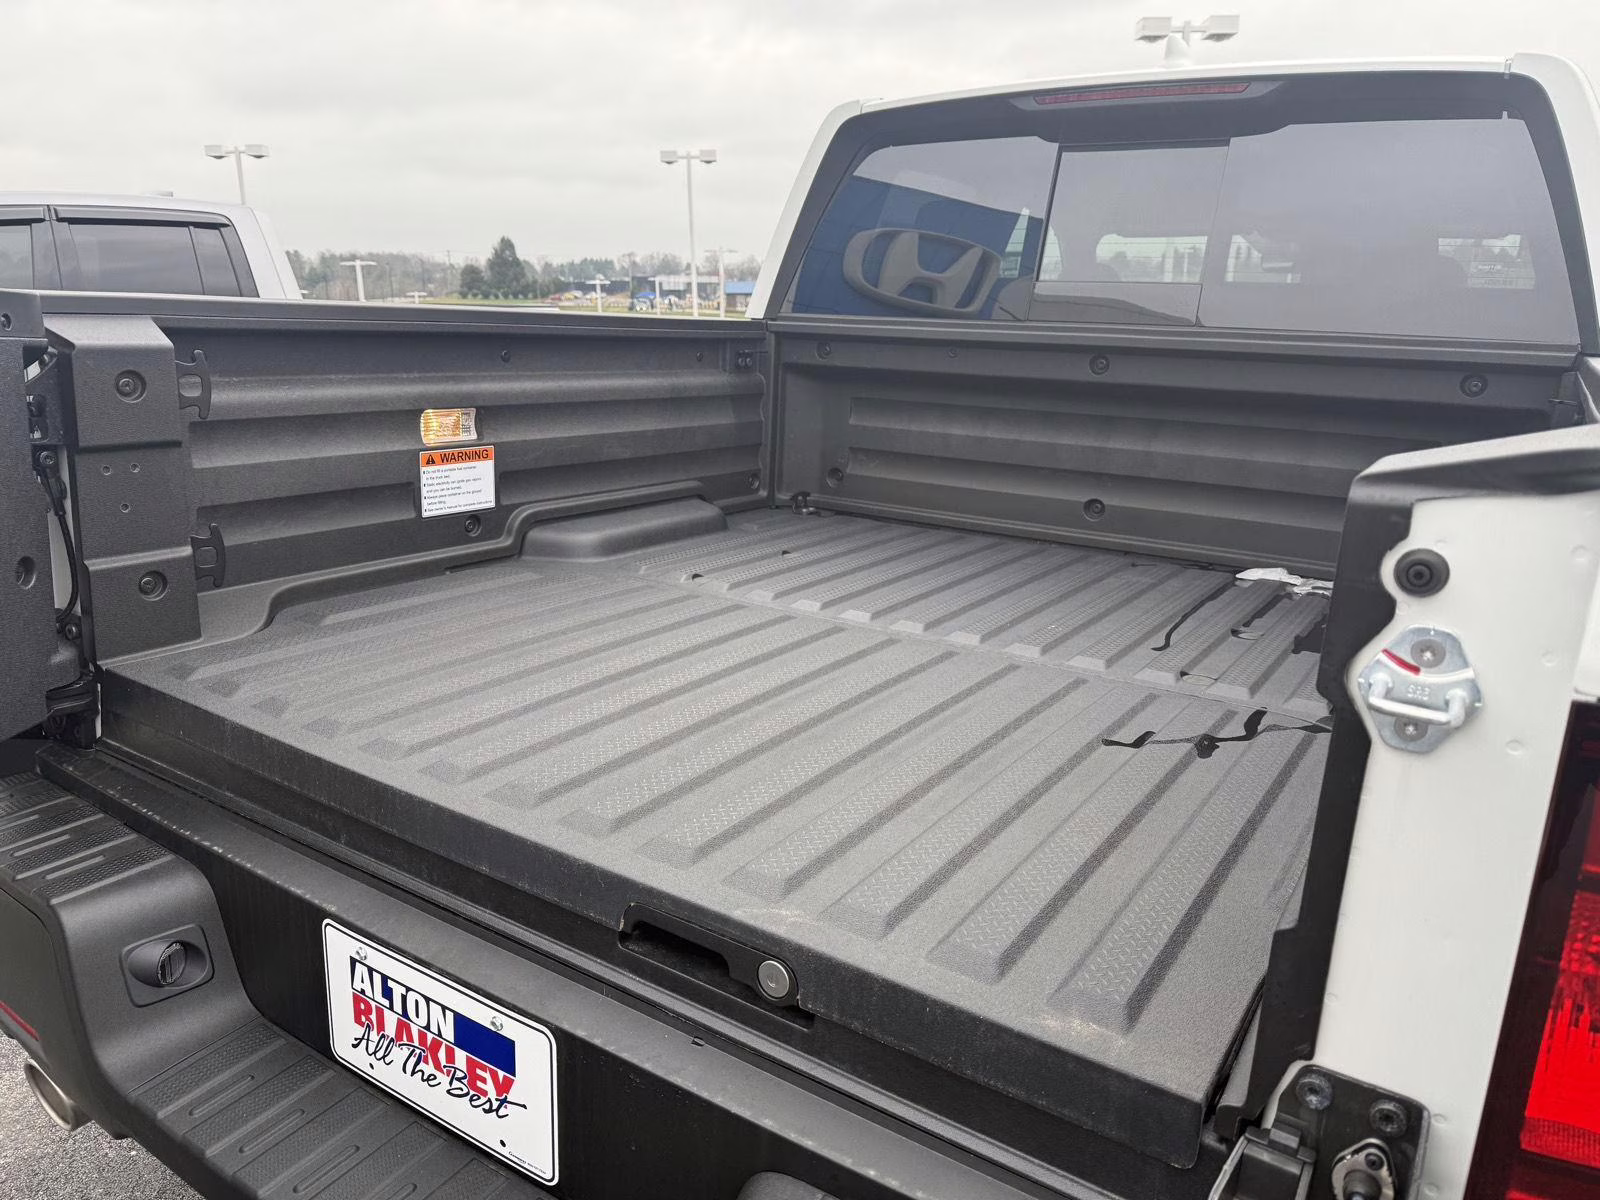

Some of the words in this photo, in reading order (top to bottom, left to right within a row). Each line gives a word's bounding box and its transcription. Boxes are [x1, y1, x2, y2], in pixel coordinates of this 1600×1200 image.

[440, 449, 489, 463] WARNING
[352, 961, 455, 1045] ALTON
[352, 991, 515, 1100] BLAKLEY
[351, 1022, 394, 1066] All
[398, 1042, 442, 1088] The
[443, 1064, 528, 1119] Best
